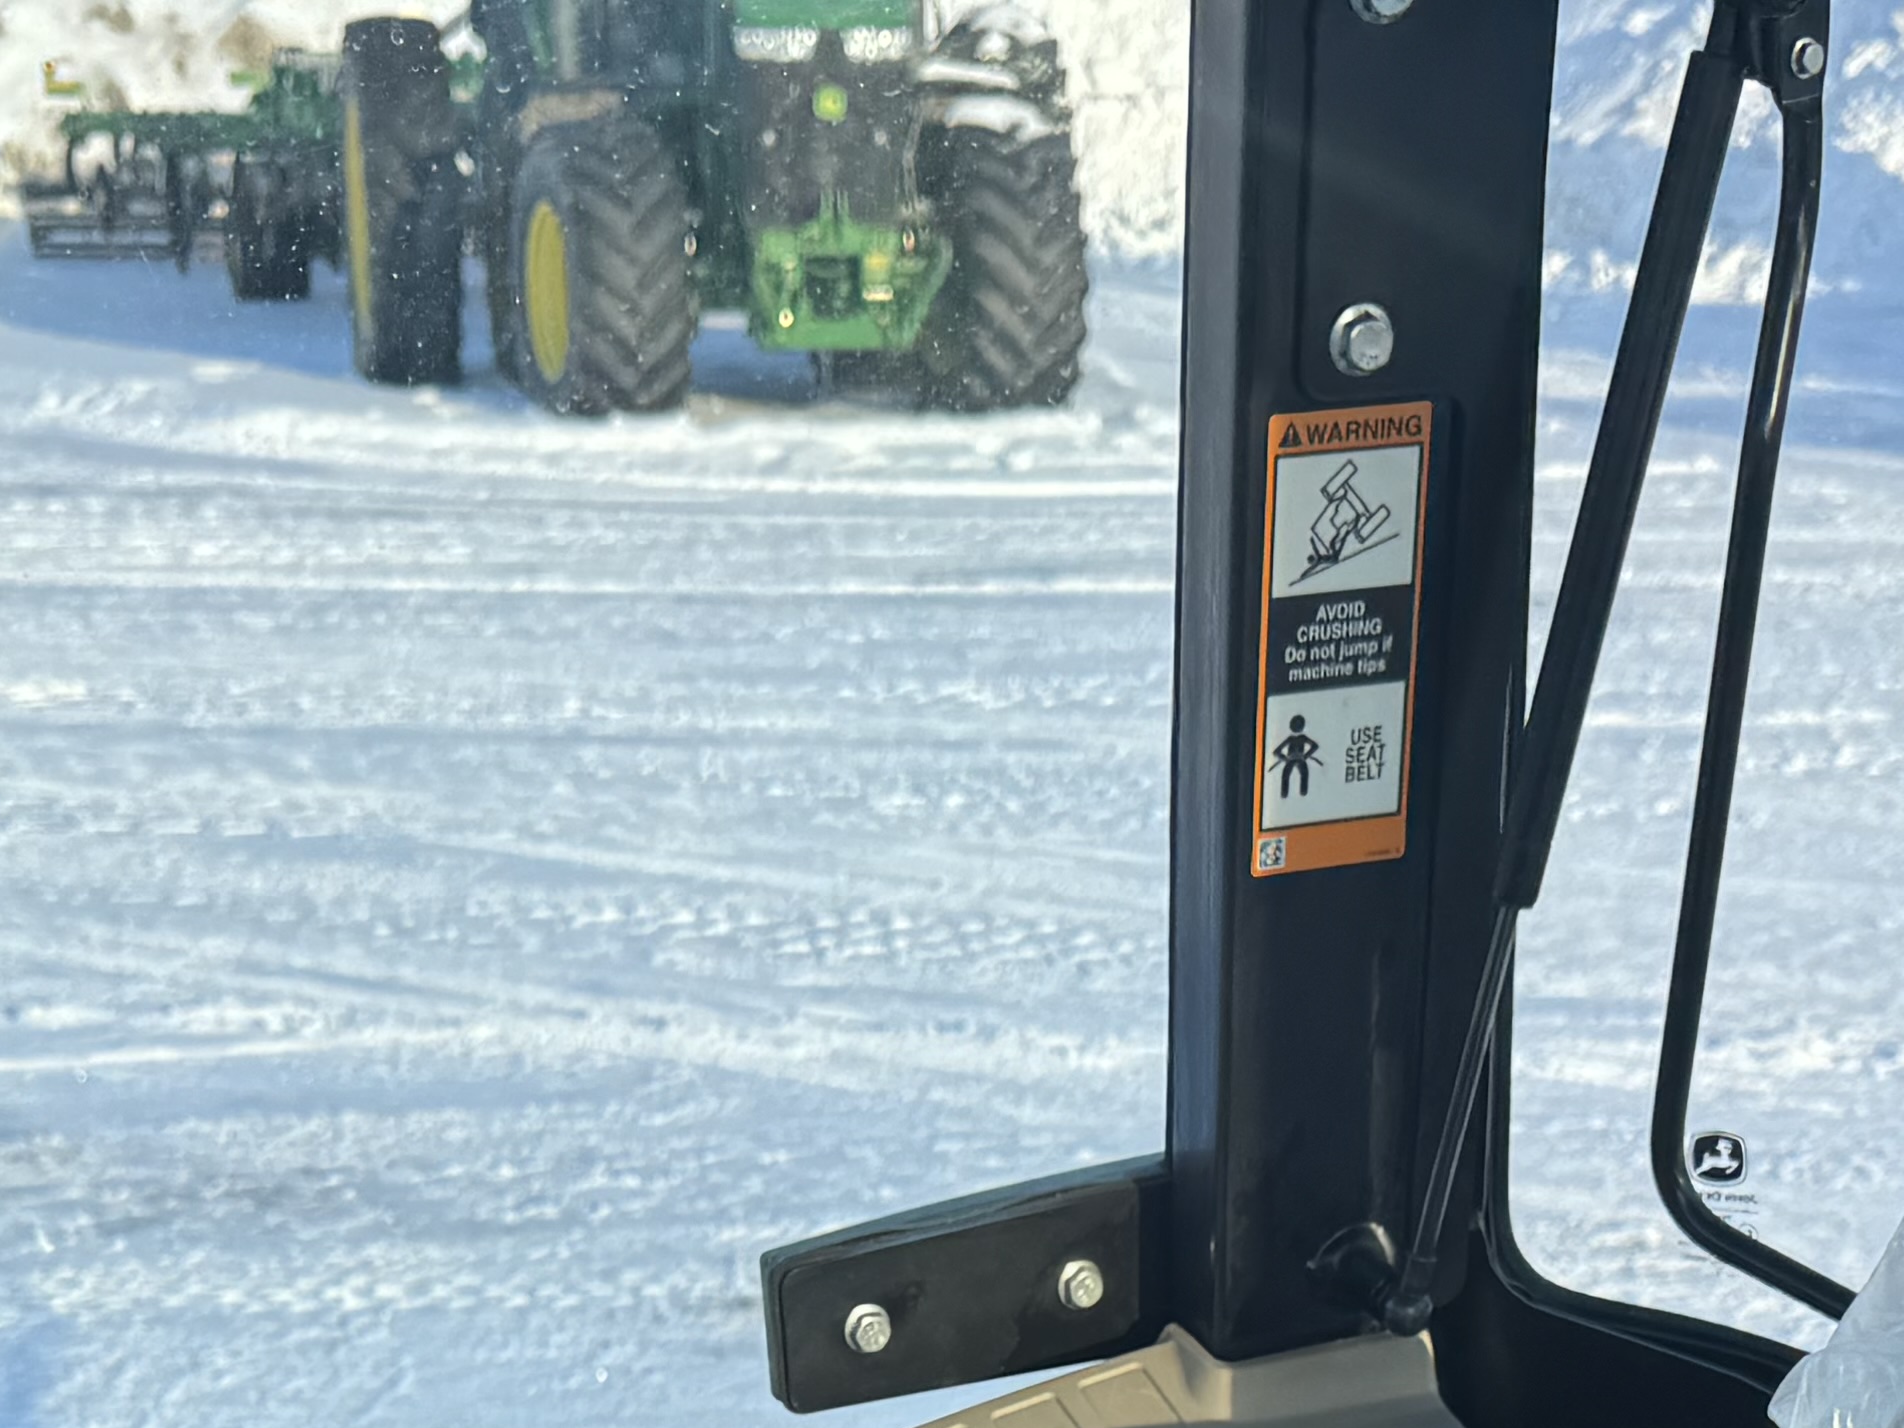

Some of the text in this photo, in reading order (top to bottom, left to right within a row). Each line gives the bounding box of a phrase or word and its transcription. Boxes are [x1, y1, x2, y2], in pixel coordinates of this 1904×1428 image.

[1306, 414, 1423, 446] WARNING
[1315, 600, 1366, 623] AVOID
[1296, 617, 1383, 644] CRUSHING
[1284, 645, 1307, 664] Do
[1310, 643, 1336, 661] not
[1339, 639, 1379, 662] jump
[1288, 657, 1387, 682] machine tips
[1350, 725, 1383, 746] USE
[1345, 743, 1386, 764] SEAT
[1345, 762, 1385, 783] BELT
